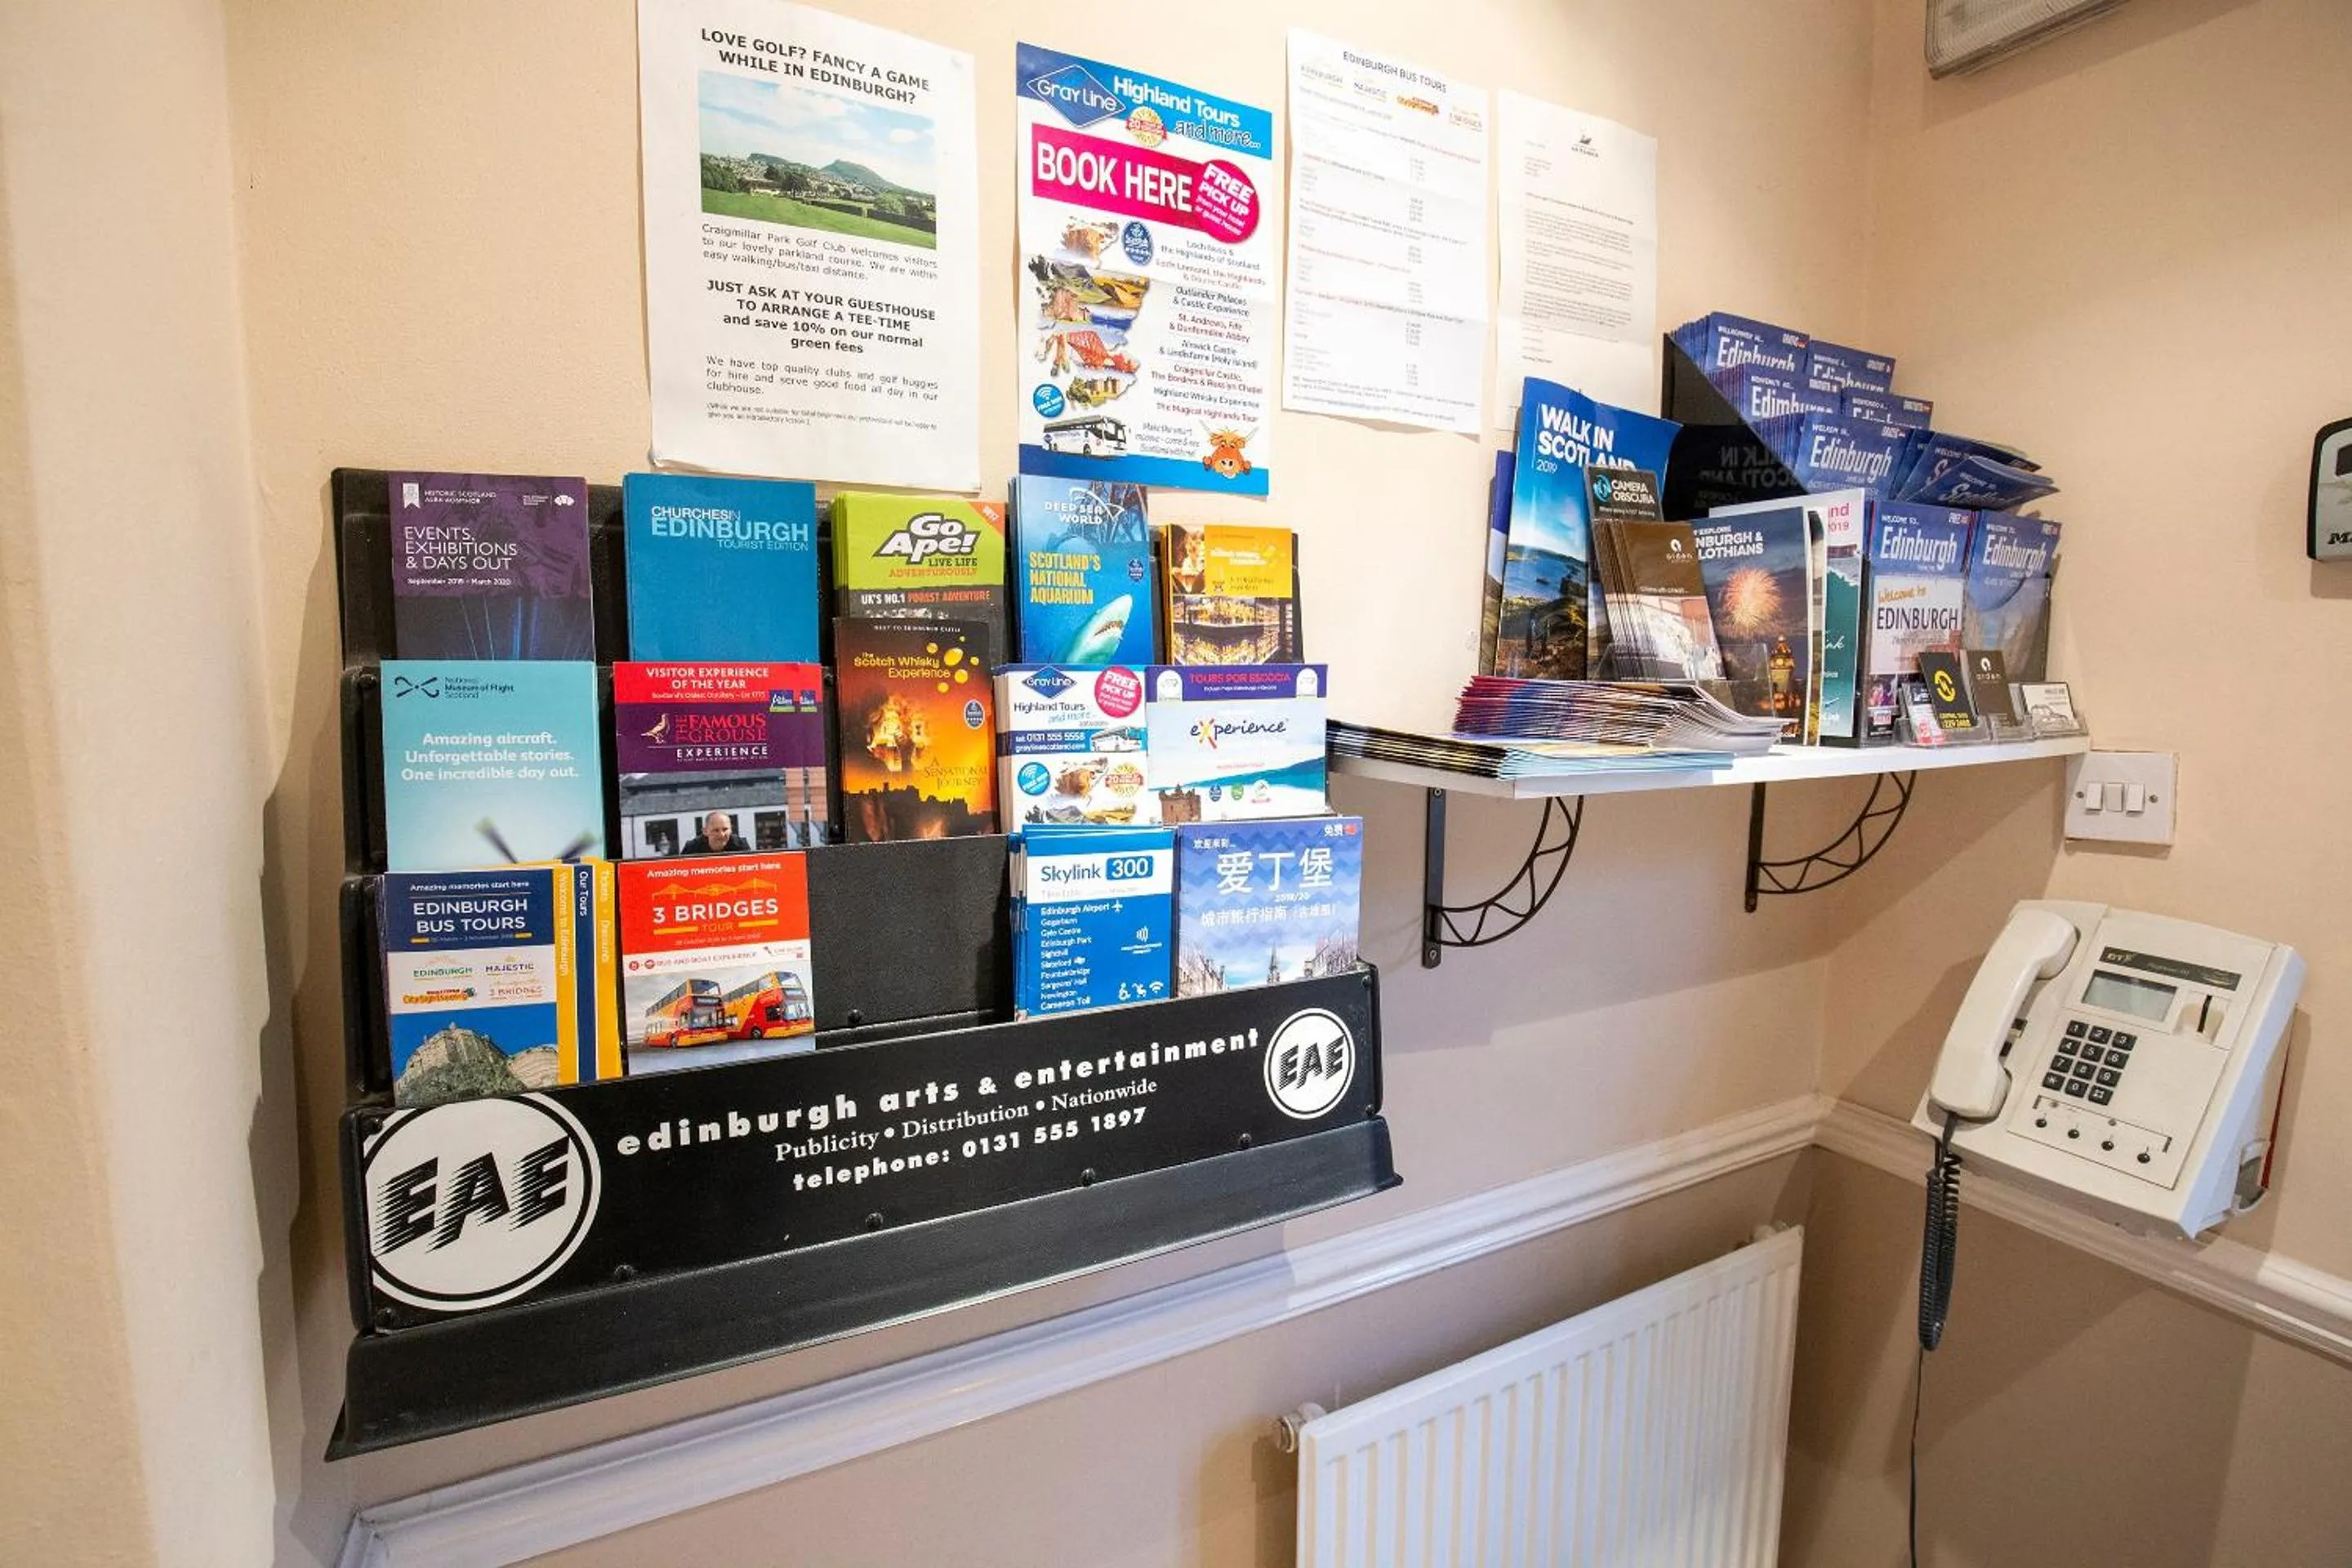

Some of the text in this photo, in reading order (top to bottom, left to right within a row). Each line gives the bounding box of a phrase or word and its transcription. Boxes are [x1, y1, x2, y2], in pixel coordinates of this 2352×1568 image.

[702, 28, 930, 91] LOVE GOLF? FANCY A GAME
[719, 50, 915, 105] WHILE IN EDINBURGH?
[1343, 51, 1447, 93] EDINBURGH BUS TOURS
[1113, 75, 1240, 127] Highland Tours
[1174, 121, 1205, 139] and
[1037, 142, 1192, 212] BOOK HERE
[1203, 164, 1255, 203] FREE
[1198, 182, 1249, 216] PICK UP
[702, 224, 761, 241] Craigmillar
[768, 233, 790, 244] Park
[796, 237, 817, 248] Golf
[823, 240, 845, 251] Club
[904, 253, 938, 269] visitors
[703, 250, 869, 281] easy walking/bus/taxi distance.
[706, 280, 935, 321] JUST ASK AT YOUR GUESTHOUSE
[737, 299, 910, 331] TO ARRANGE A TEE-TIME
[724, 313, 923, 348] and save 10% on our normal
[791, 337, 863, 354] green fees
[1540, 404, 1614, 450] WALK IN
[1536, 460, 1557, 474] 2019
[1810, 435, 1892, 483] Edinburgh
[1611, 479, 1648, 492] CAMERA
[1613, 492, 1655, 505] OBSCURA
[1045, 501, 1102, 514] DEEP SEA
[910, 514, 963, 537] Go
[1059, 514, 1102, 524] WORLD
[1882, 514, 1907, 523] WELCOME
[405, 527, 474, 541] EVENTS,
[651, 517, 808, 541] EDINBURGH
[406, 541, 517, 555] EXHIBITIONS
[718, 539, 808, 551] TOURIST EDITION
[880, 532, 976, 563] Ape!
[1695, 532, 1762, 548] NBURGH &
[1881, 526, 1958, 570] Edinburgh
[1699, 542, 1763, 559] LOTHIANS
[1982, 534, 2047, 577] Edinburgh
[406, 556, 511, 570] & DAYS OUT
[929, 559, 953, 567] LIVE
[1029, 551, 1101, 572] SCOTLAND'S
[889, 568, 977, 577] ADVENTUROUSLY
[1030, 569, 1086, 587] NATIONAL
[862, 590, 991, 604] UK'S NO.1 FOREST ADVENTURE
[1030, 588, 1094, 605] AQUARIUM
[1877, 608, 1958, 630] EDINBURGH
[854, 657, 940, 668] Scotch Whisky
[646, 667, 769, 678] VISITOR EXPERIENCE
[888, 668, 951, 679] Experience
[1189, 672, 1290, 684] TOURS POR ESCOCIA
[672, 679, 746, 689] OF THE YEAR
[1014, 702, 1085, 714] Highland Tours
[675, 715, 688, 742] THE
[688, 713, 766, 728] FAMOUS
[422, 732, 557, 746] Amazing aircraft.
[688, 728, 767, 742] GROUSE
[405, 751, 574, 766] Unforgettable stories.
[676, 746, 768, 758] EXPERIENCE
[402, 767, 578, 780] One incredible day out.
[1041, 858, 1148, 883] Skylink 300
[1216, 848, 1333, 894] 爱丁堡
[410, 883, 447, 892] Amazing
[449, 882, 489, 890] memories
[413, 899, 528, 915] EDINBURGH
[653, 898, 778, 923] 3 BRIDGES
[1041, 903, 1110, 915] Edinburgh Airport
[416, 917, 525, 933] BUS TOURS
[702, 921, 733, 933] TOUR
[1041, 938, 1076, 947] Edinburgh
[414, 967, 473, 978] EDINBURGH
[485, 964, 534, 973] MAJESTIC
[1041, 996, 1090, 1010] Cameron Toll
[1278, 1035, 1345, 1092] EAE
[617, 1029, 1259, 1155] edinburgh arts & entertainment
[775, 1079, 1157, 1162] Publicity Distribution Nationwide
[793, 1107, 1147, 1192] telephone: 0131 555 1897
[373, 1137, 569, 1256] EAE
